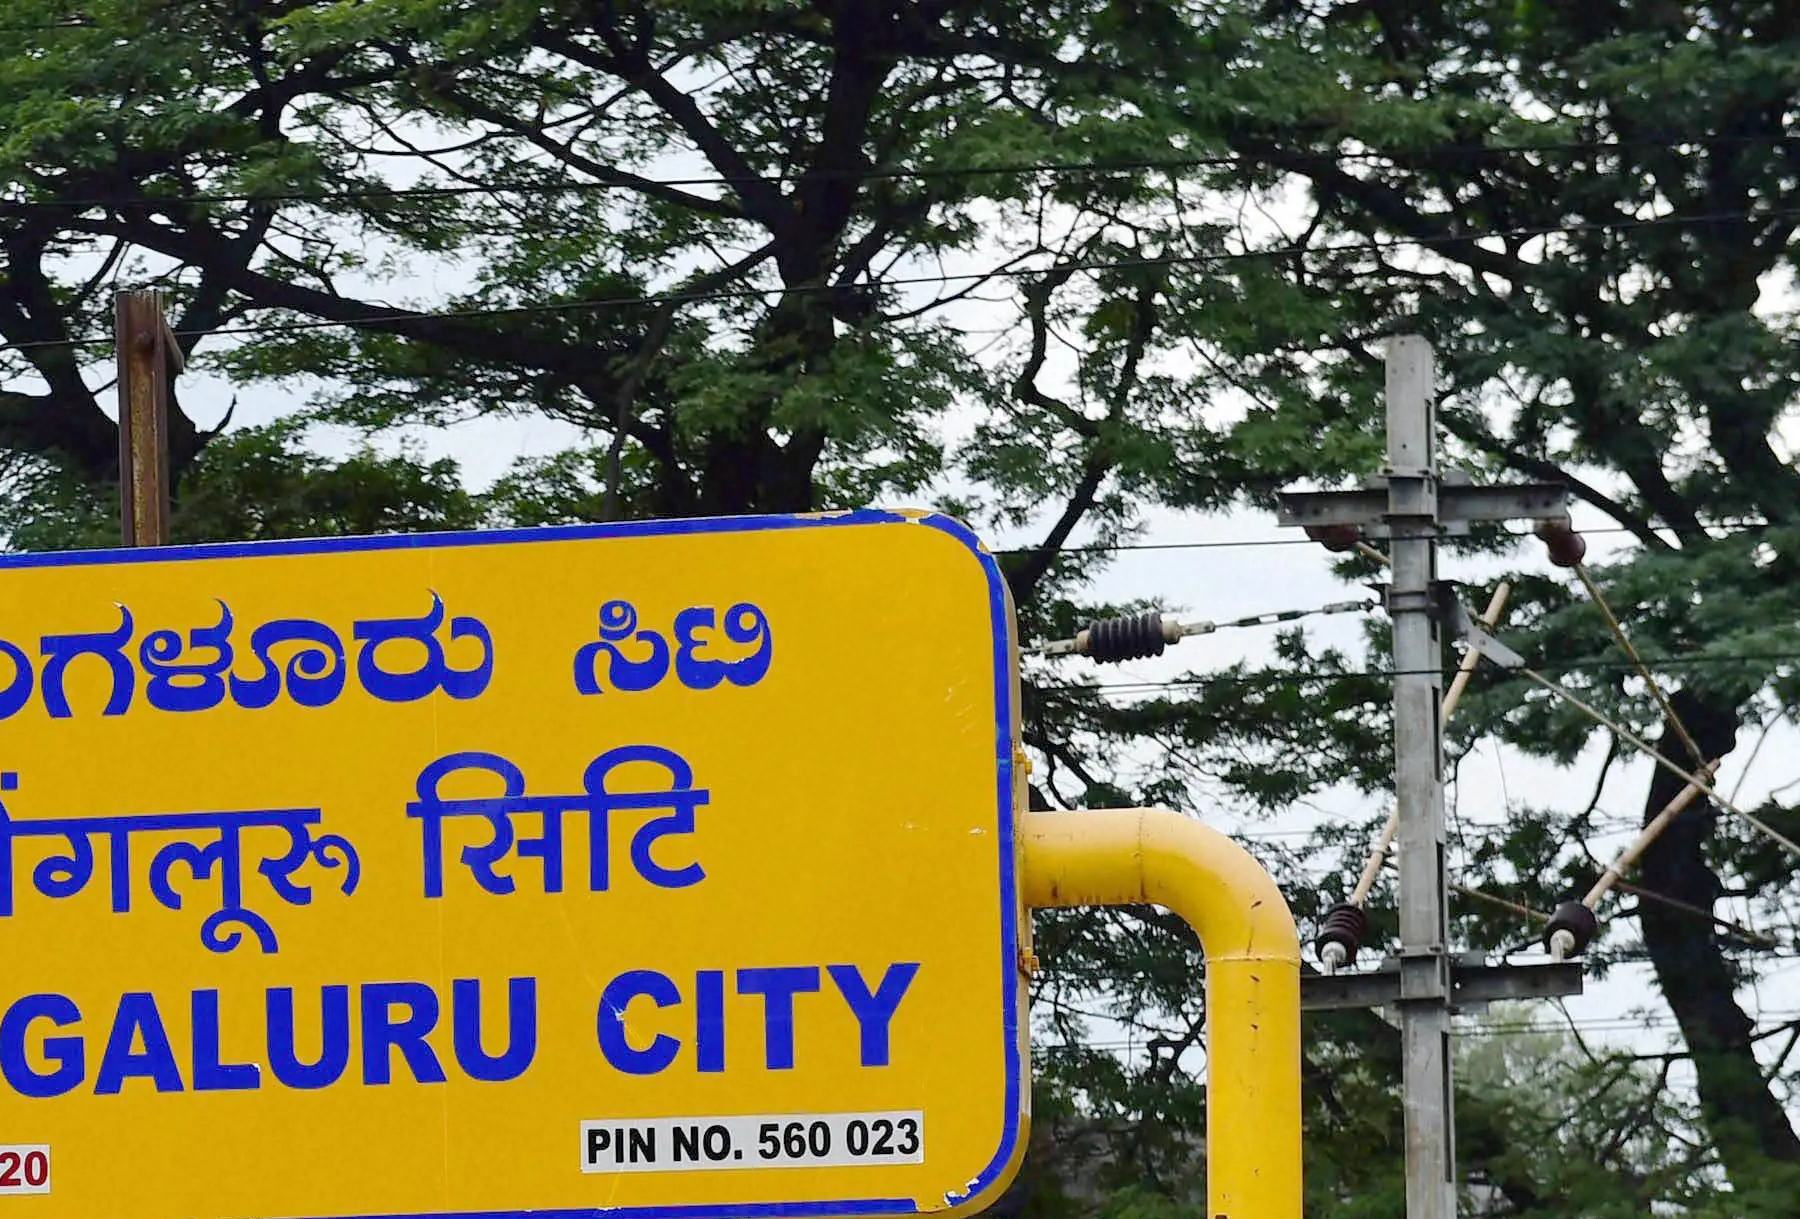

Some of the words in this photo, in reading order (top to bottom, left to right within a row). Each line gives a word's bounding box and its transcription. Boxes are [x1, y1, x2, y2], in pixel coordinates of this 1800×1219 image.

[574, 600, 773, 695] ಸಿಟಿ
[406, 745, 710, 898] सिटि
[597, 962, 919, 1075] CITY
[587, 1127, 656, 1164] PIN
[672, 1124, 743, 1162] NO.
[758, 1121, 831, 1159] 560
[846, 1118, 920, 1156] 023
